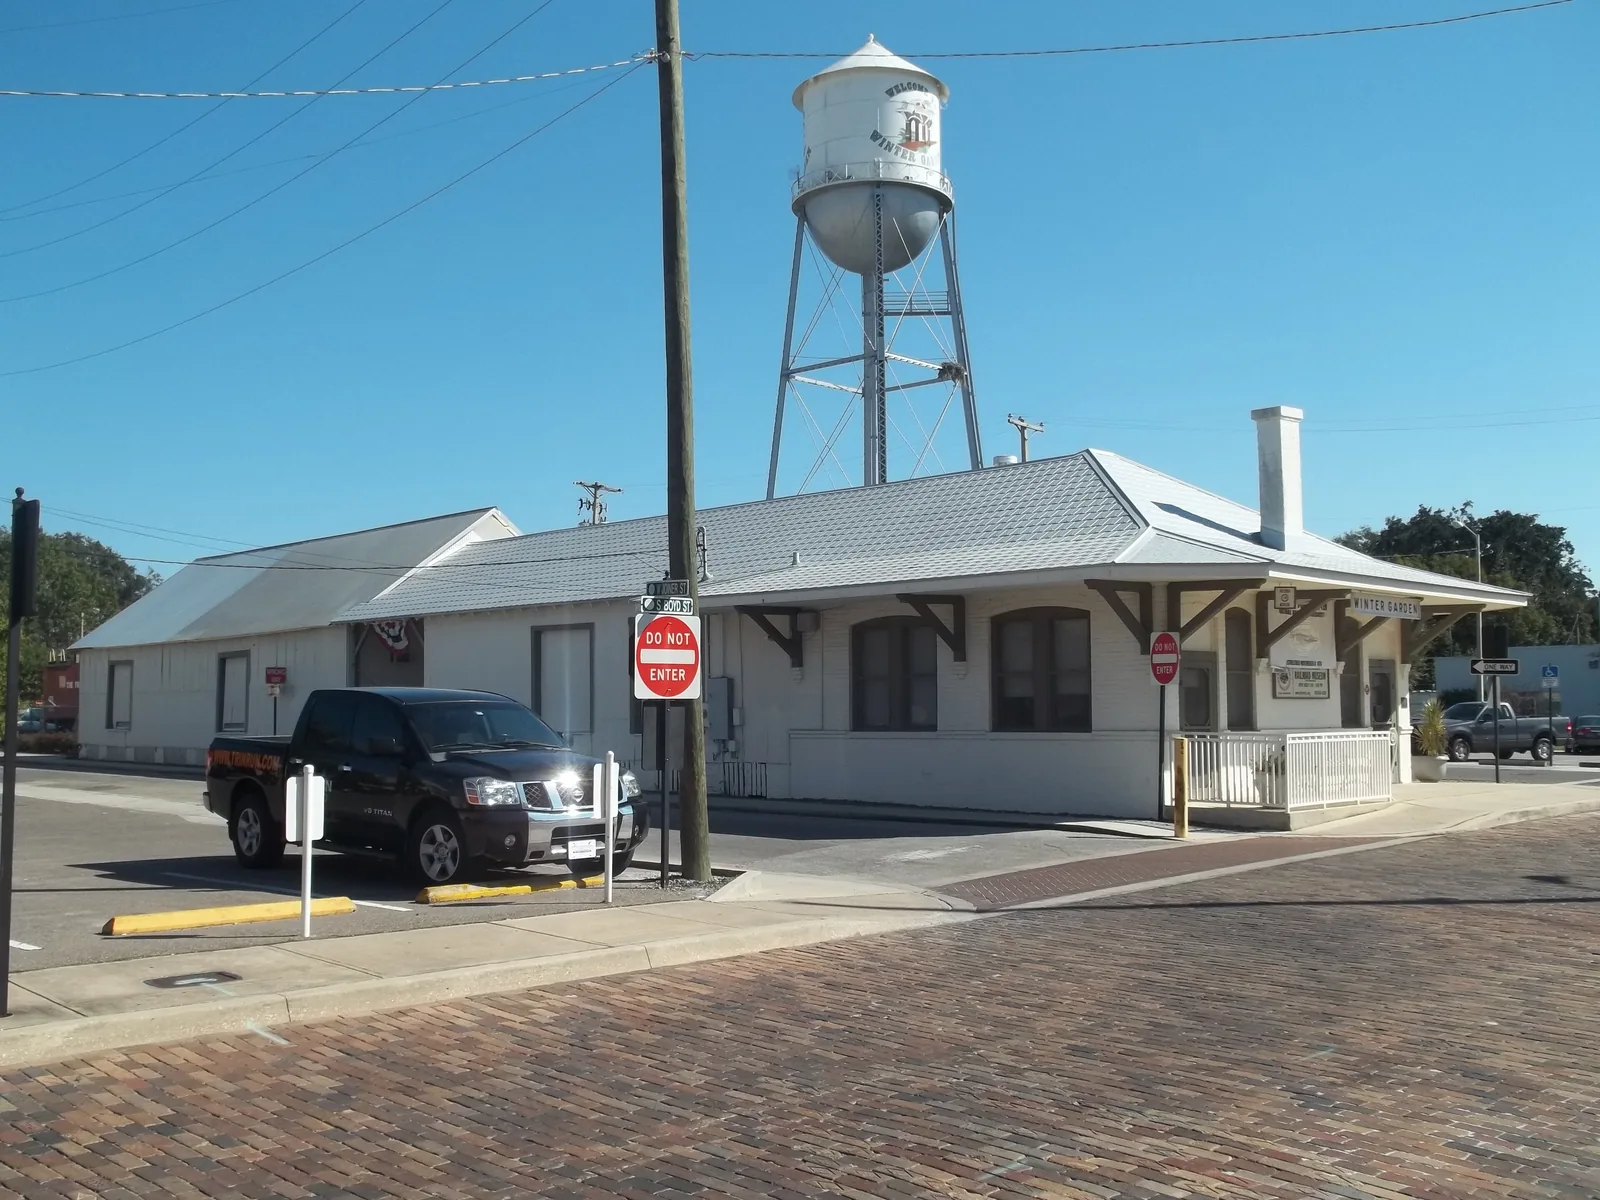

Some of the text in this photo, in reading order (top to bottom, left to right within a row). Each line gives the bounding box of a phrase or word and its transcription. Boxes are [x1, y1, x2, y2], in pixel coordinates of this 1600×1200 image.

[869, 129, 917, 163] WINTER
[679, 582, 687, 594] ST
[656, 599, 691, 612] S BOYD ST
[1353, 597, 1418, 614] WINTER GARDEN
[646, 631, 690, 645] DO NOT
[1154, 642, 1175, 652] DO NOT
[1156, 665, 1173, 675] ENTER
[1483, 663, 1514, 671] ONE WAY
[650, 668, 686, 681] ENTER
[373, 808, 393, 817] TITAN
